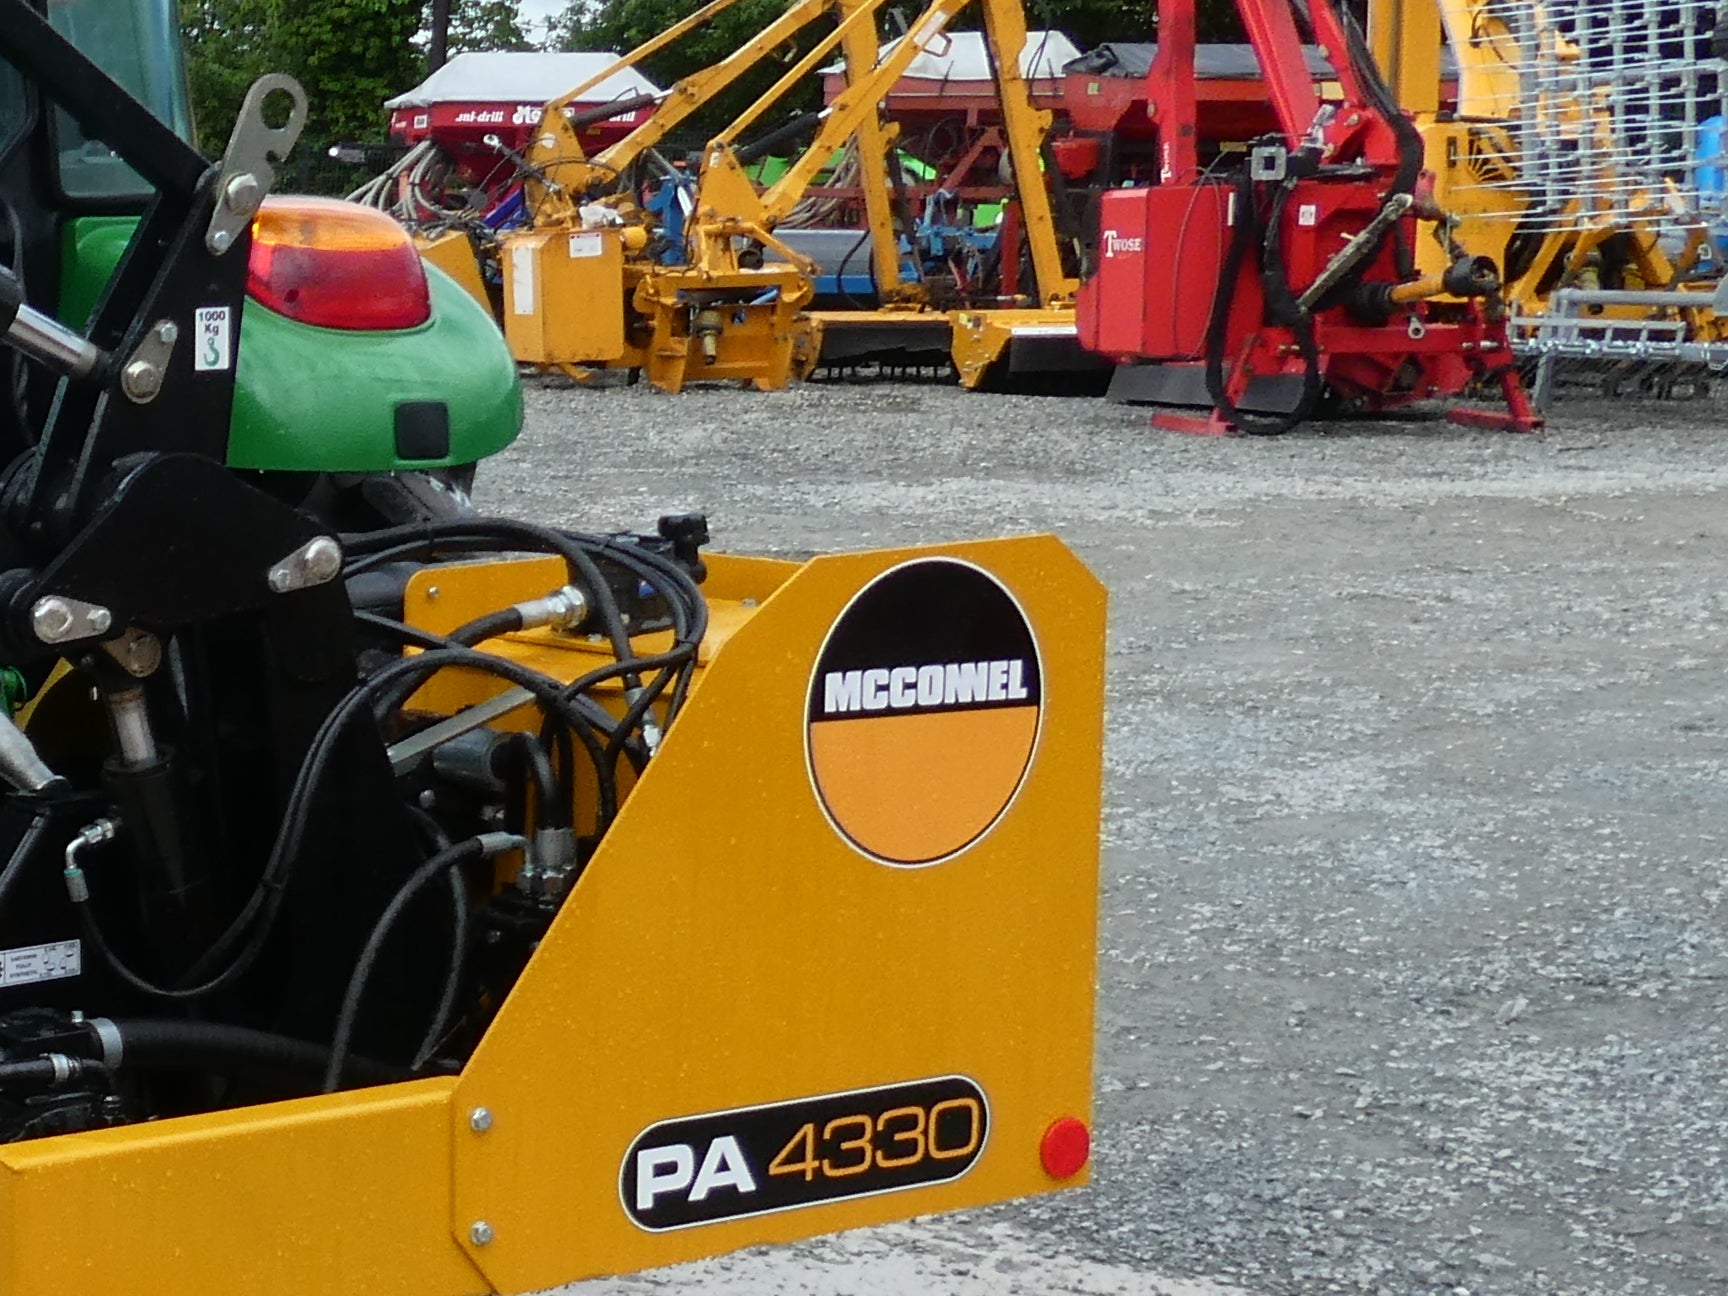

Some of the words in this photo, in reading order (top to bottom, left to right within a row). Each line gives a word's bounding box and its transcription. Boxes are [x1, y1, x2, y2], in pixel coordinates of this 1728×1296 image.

[199, 310, 226, 322] 1000
[204, 323, 220, 336] Kg
[824, 659, 1029, 714] MCCONNEL
[636, 1135, 757, 1211] PA
[767, 1098, 980, 1182] 4330
